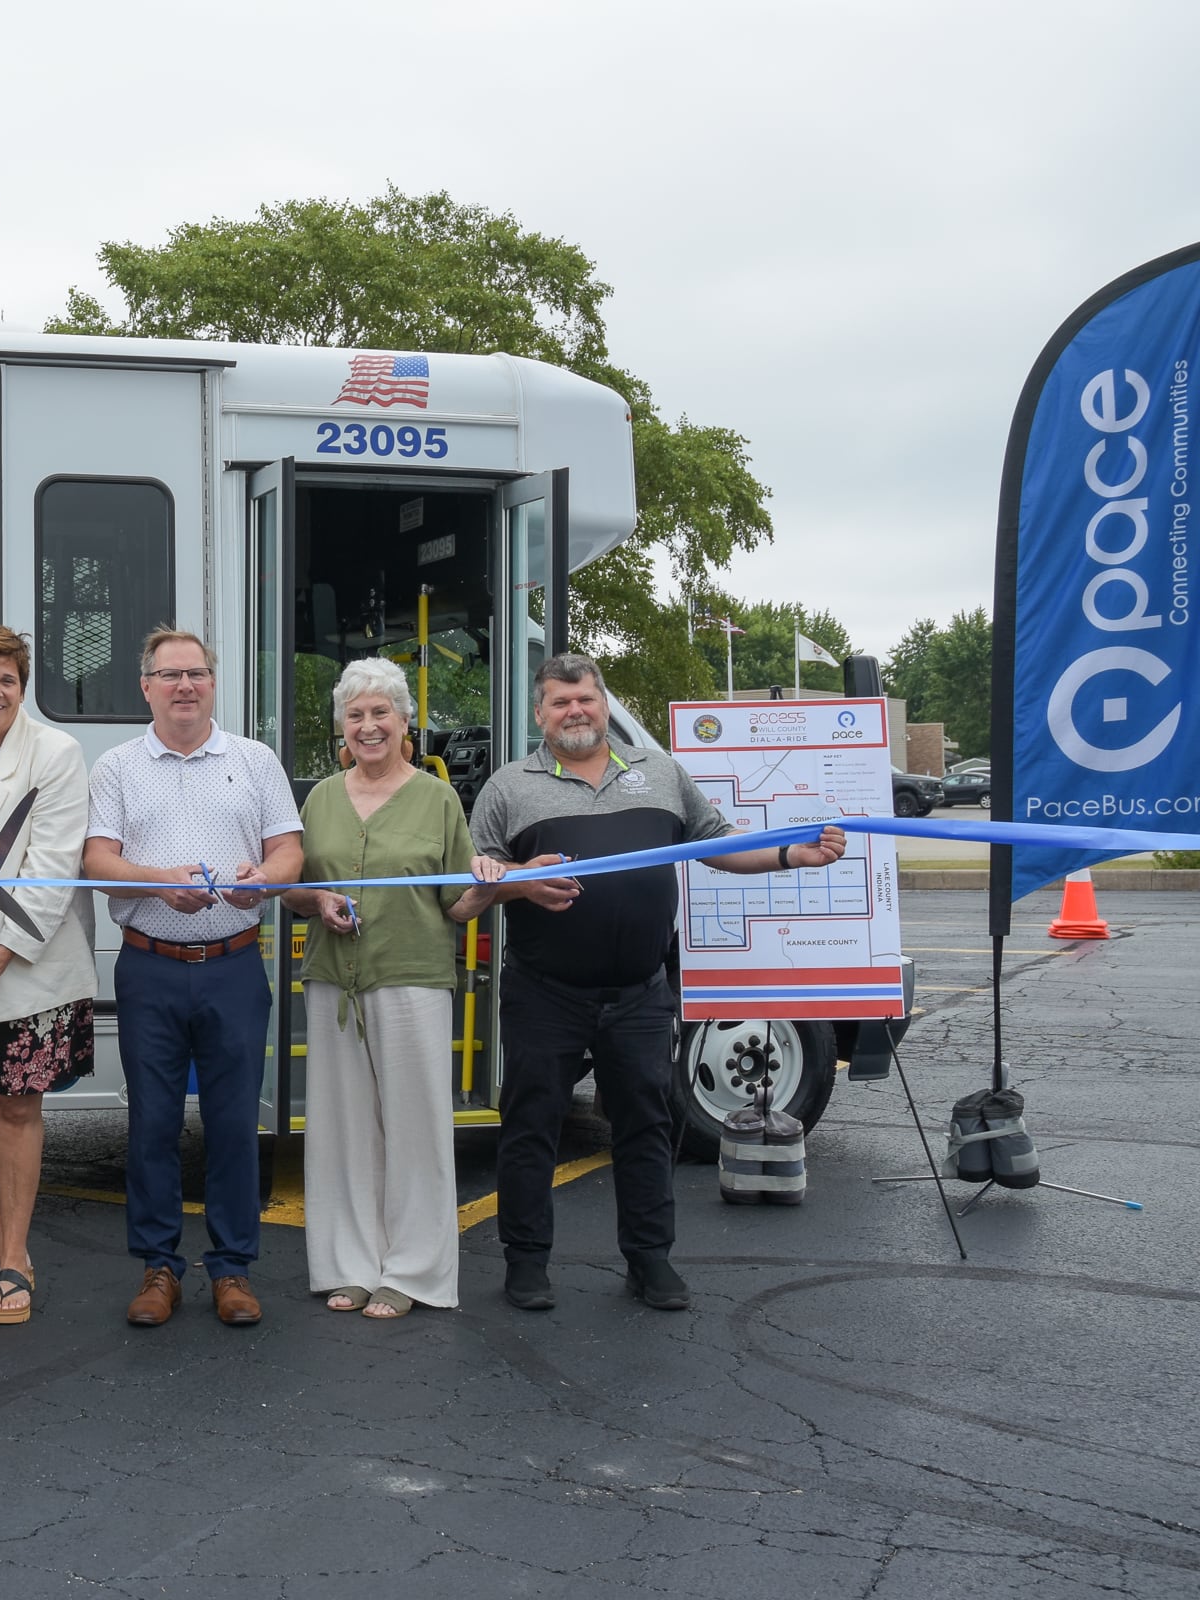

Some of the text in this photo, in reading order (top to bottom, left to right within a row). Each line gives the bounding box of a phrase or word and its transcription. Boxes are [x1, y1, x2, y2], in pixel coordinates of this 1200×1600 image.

[316, 422, 449, 459] 23095
[1080, 368, 1162, 632] pace
[1169, 359, 1191, 626] Connecting Communities
[420, 537, 452, 563] 23095
[749, 711, 807, 724] access
[750, 735, 808, 743] DIAL-A-RIDE
[831, 730, 863, 741] pace
[883, 862, 893, 912] LAKE COUNTY
[827, 938, 858, 946] COUNTY
